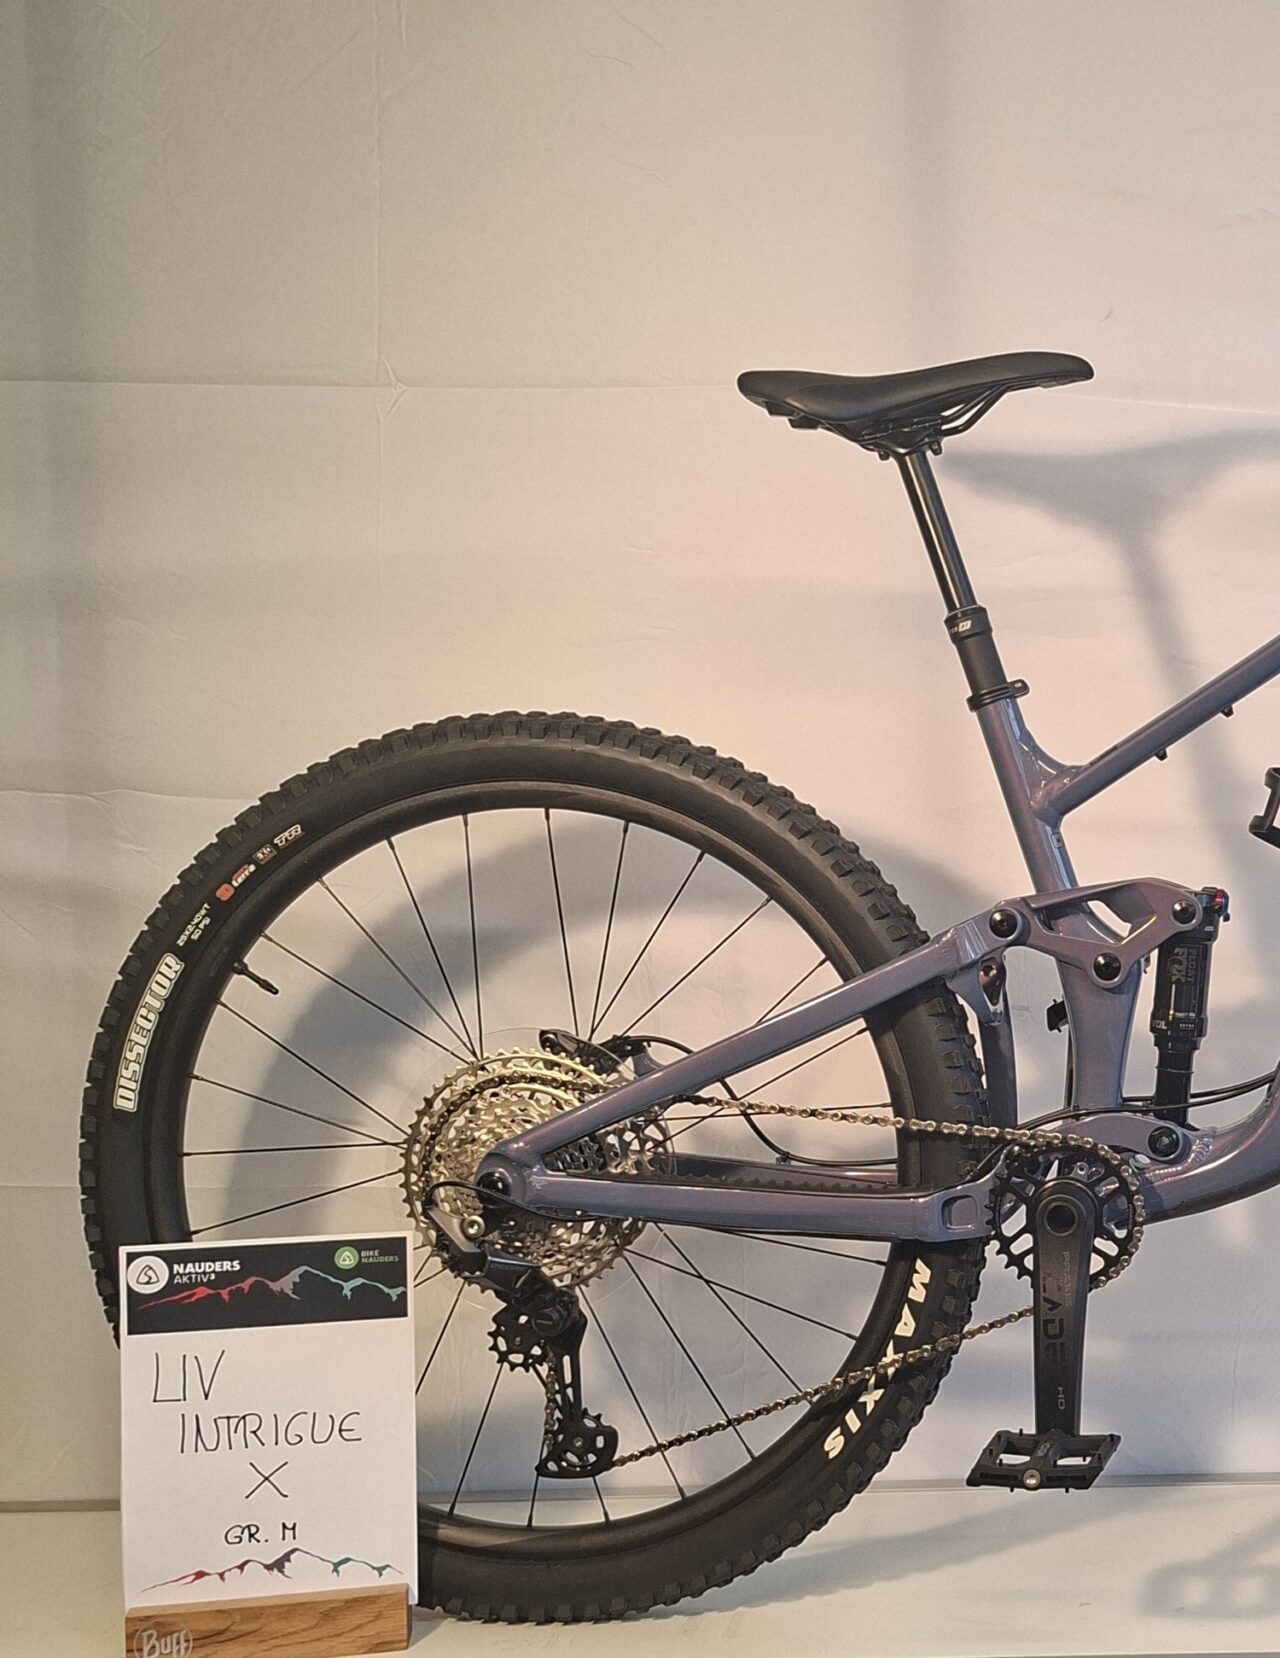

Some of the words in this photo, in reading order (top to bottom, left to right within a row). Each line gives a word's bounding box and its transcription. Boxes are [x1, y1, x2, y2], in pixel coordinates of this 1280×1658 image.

[1167, 946, 1188, 983] FOX
[113, 953, 184, 1112] DISSECTOR
[173, 1259, 241, 1275] NAUDERS
[361, 1249, 380, 1257] BIKE
[361, 1254, 399, 1263] NAUDERS
[152, 1349, 226, 1403] LIV
[823, 1257, 932, 1459] MAXXIS
[1057, 1386, 1066, 1410] HD
[180, 1411, 363, 1454] INTRIGUE
[245, 1461, 289, 1499] X
[224, 1523, 269, 1545] GR.
[281, 1521, 298, 1542] M
